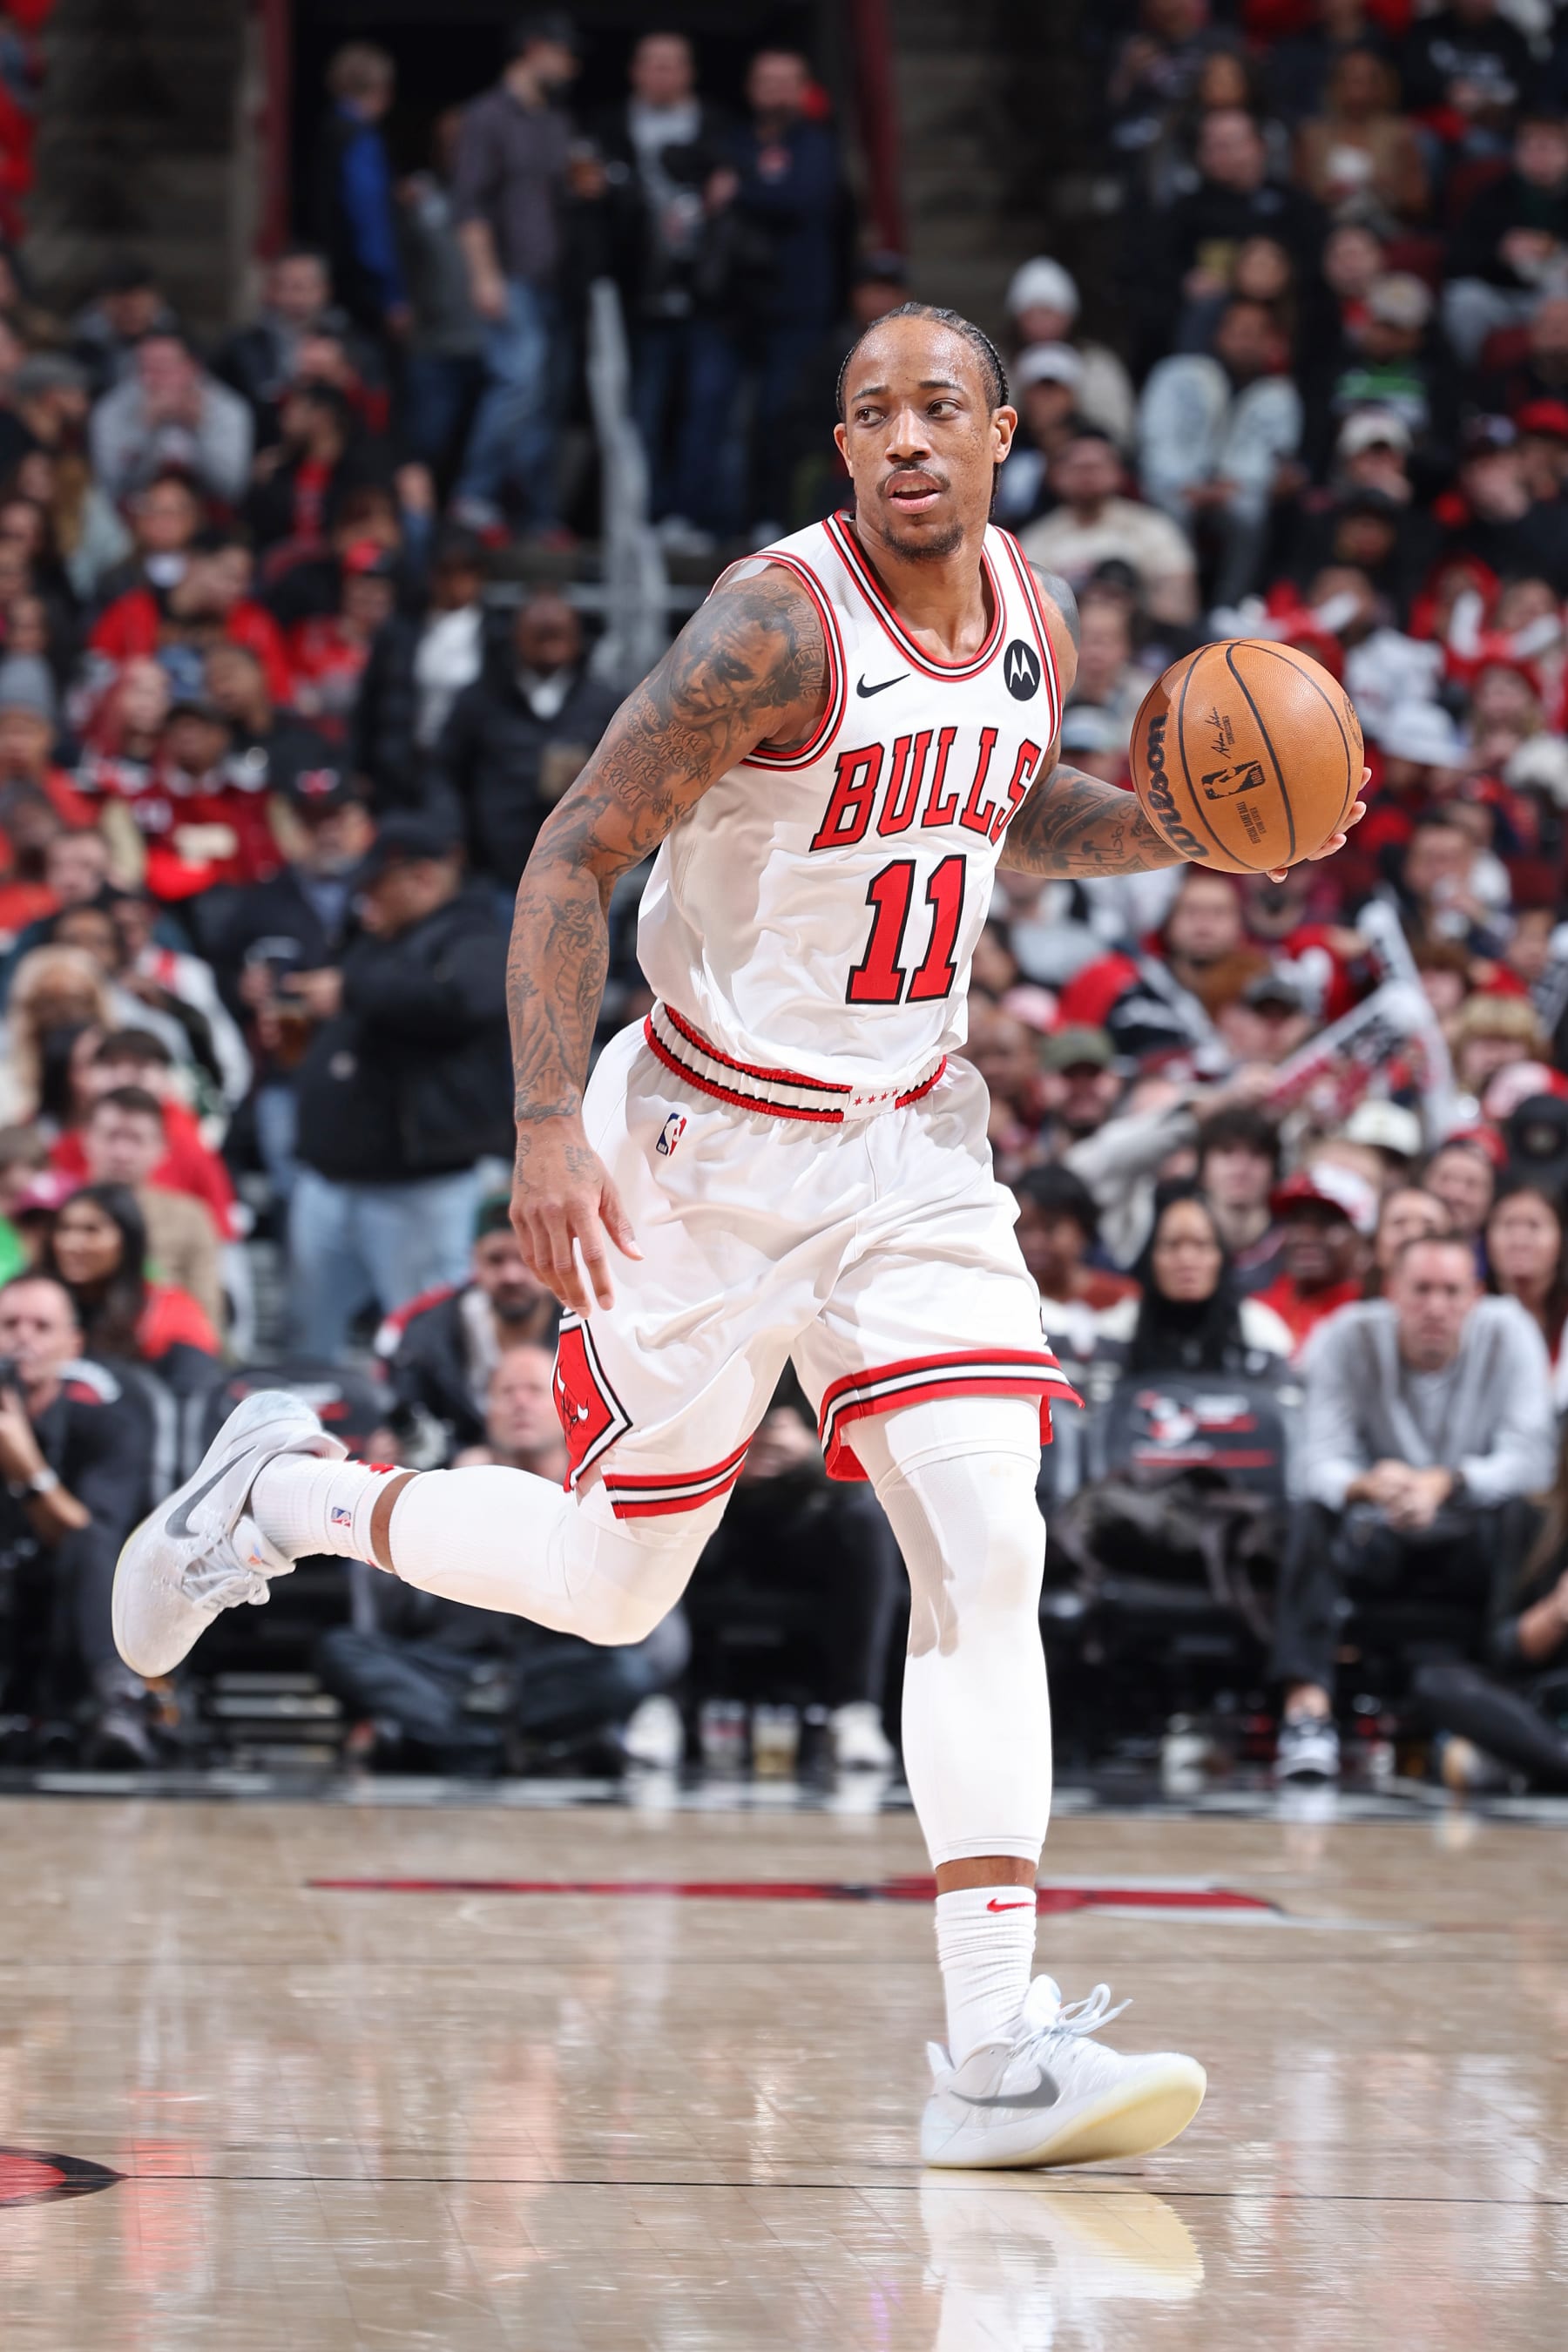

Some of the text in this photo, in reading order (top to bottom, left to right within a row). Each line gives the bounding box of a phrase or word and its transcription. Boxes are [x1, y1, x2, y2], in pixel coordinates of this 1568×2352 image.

[809, 727, 1041, 852] BULLS
[1250, 767, 1263, 785] NBA
[845, 855, 966, 1004] 11
